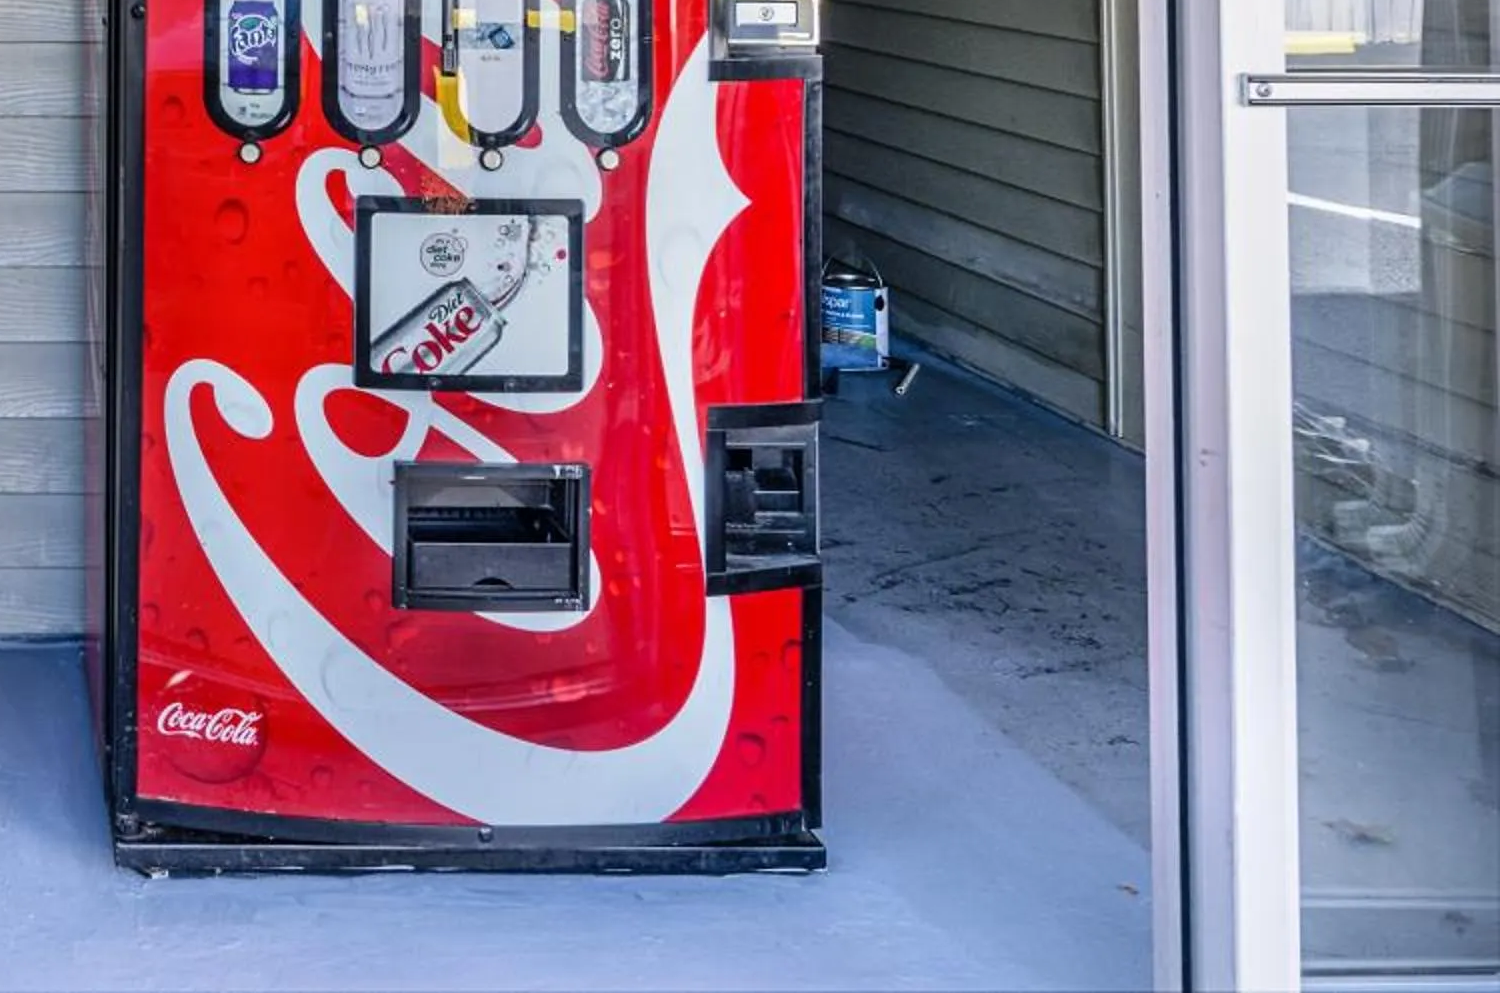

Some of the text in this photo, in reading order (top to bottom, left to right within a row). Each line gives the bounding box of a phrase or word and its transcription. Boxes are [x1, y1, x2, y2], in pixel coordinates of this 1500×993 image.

[609, 17, 621, 60] zero
[428, 292, 465, 323] Diet
[157, 702, 263, 745] Coca-Cola
